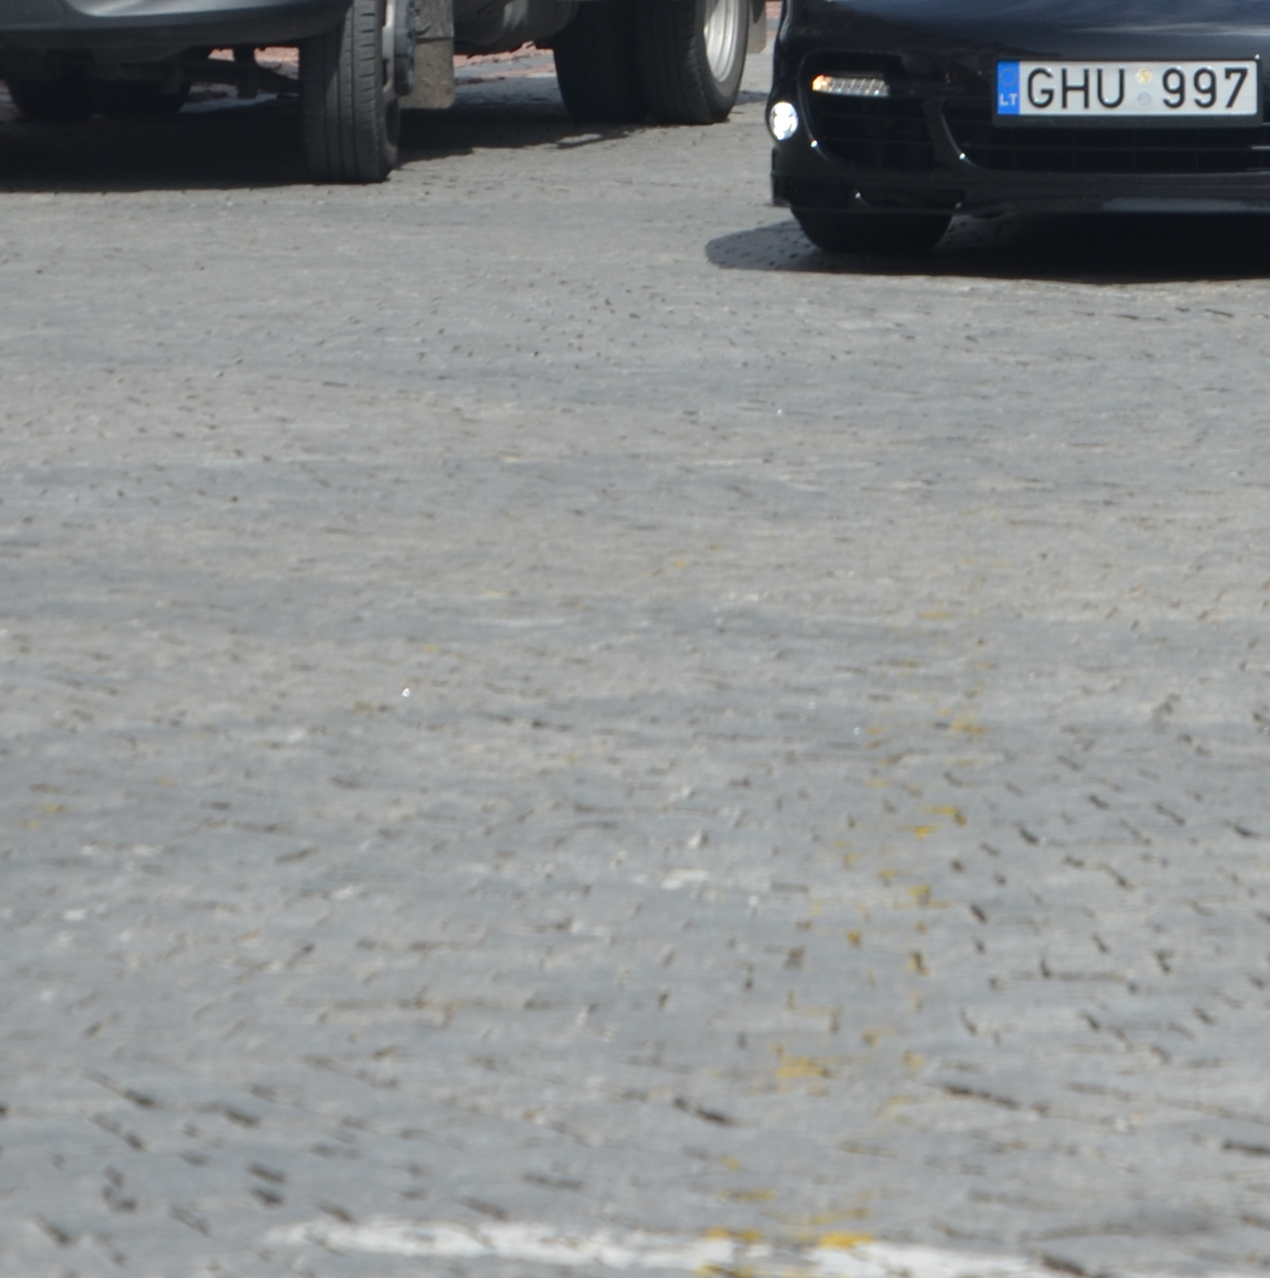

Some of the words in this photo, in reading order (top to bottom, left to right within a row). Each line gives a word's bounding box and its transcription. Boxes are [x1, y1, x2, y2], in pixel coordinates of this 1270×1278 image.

[998, 93, 1018, 107] LT
[1027, 67, 1126, 109] GHU
[1162, 66, 1249, 109] 997
